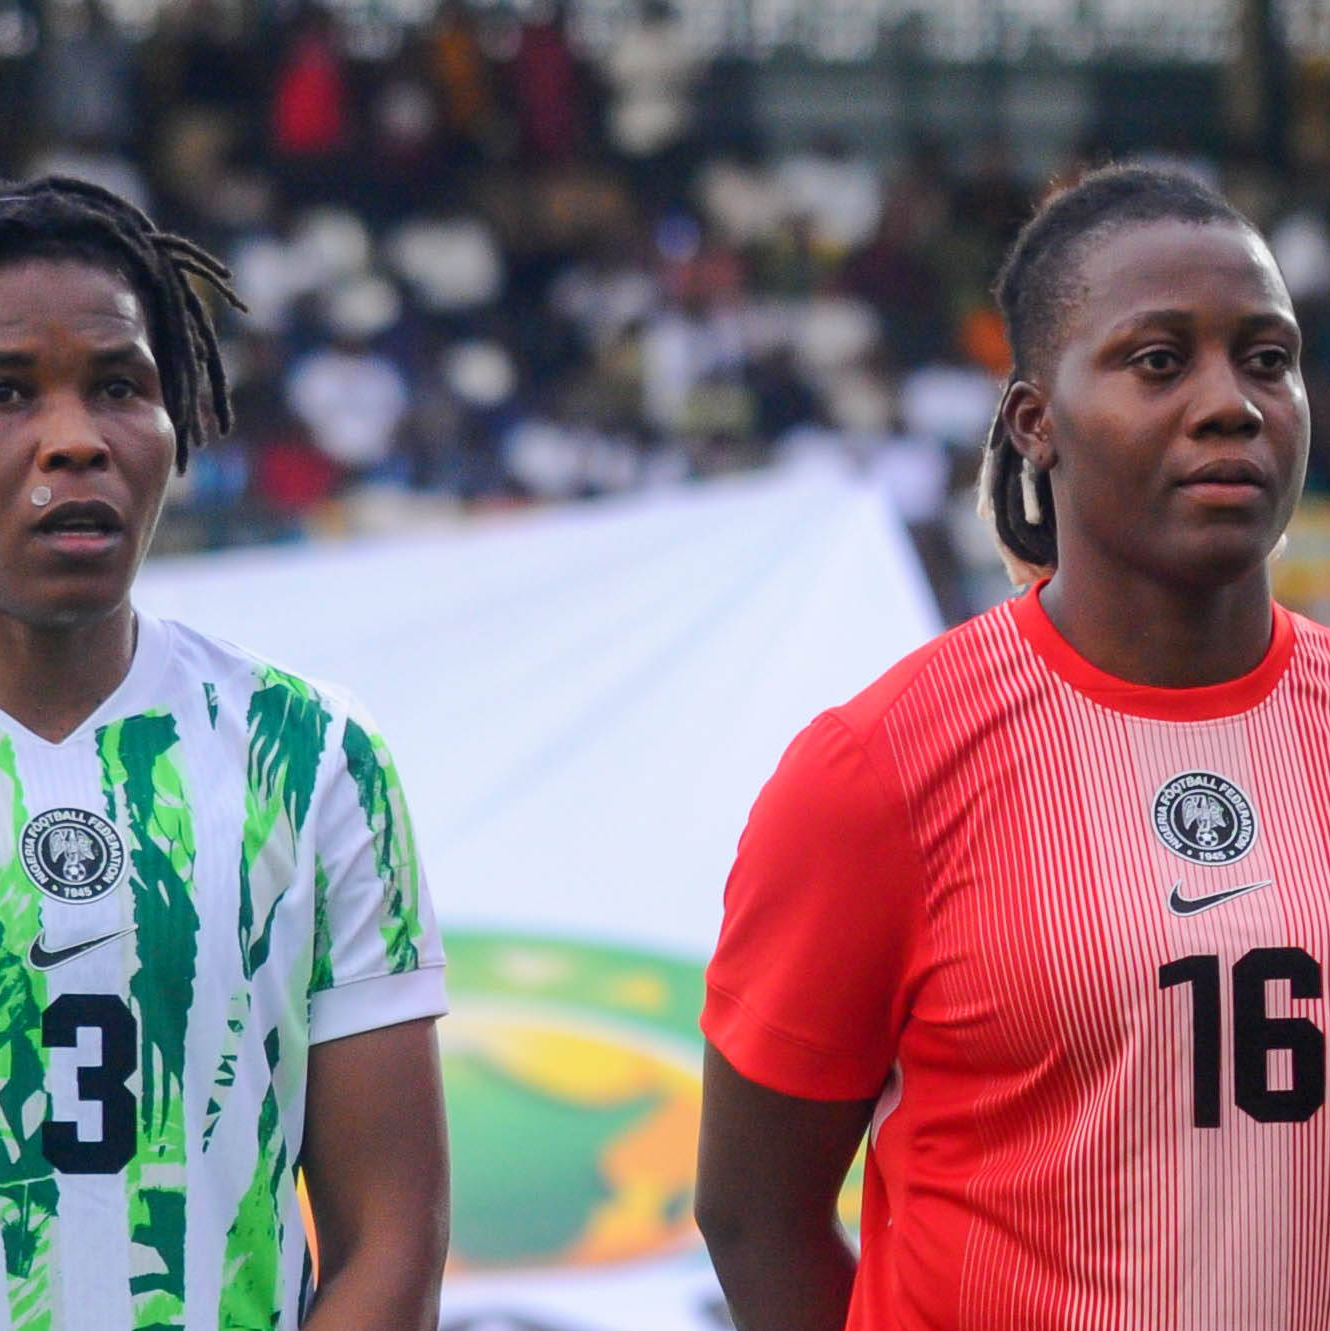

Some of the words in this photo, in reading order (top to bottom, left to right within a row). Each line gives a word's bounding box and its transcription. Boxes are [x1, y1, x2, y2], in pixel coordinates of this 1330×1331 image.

[1160, 776, 1217, 806] FOOTBALL
[28, 811, 86, 838] FOOTBALL
[1157, 807, 1183, 850] NIGERIA
[1219, 783, 1252, 850] FEDERATION
[25, 839, 49, 884] NIGERIA
[88, 817, 121, 884] FEDERATION
[64, 887, 92, 898] 1945
[1159, 947, 1326, 1128] 16
[42, 994, 137, 1174] 3
